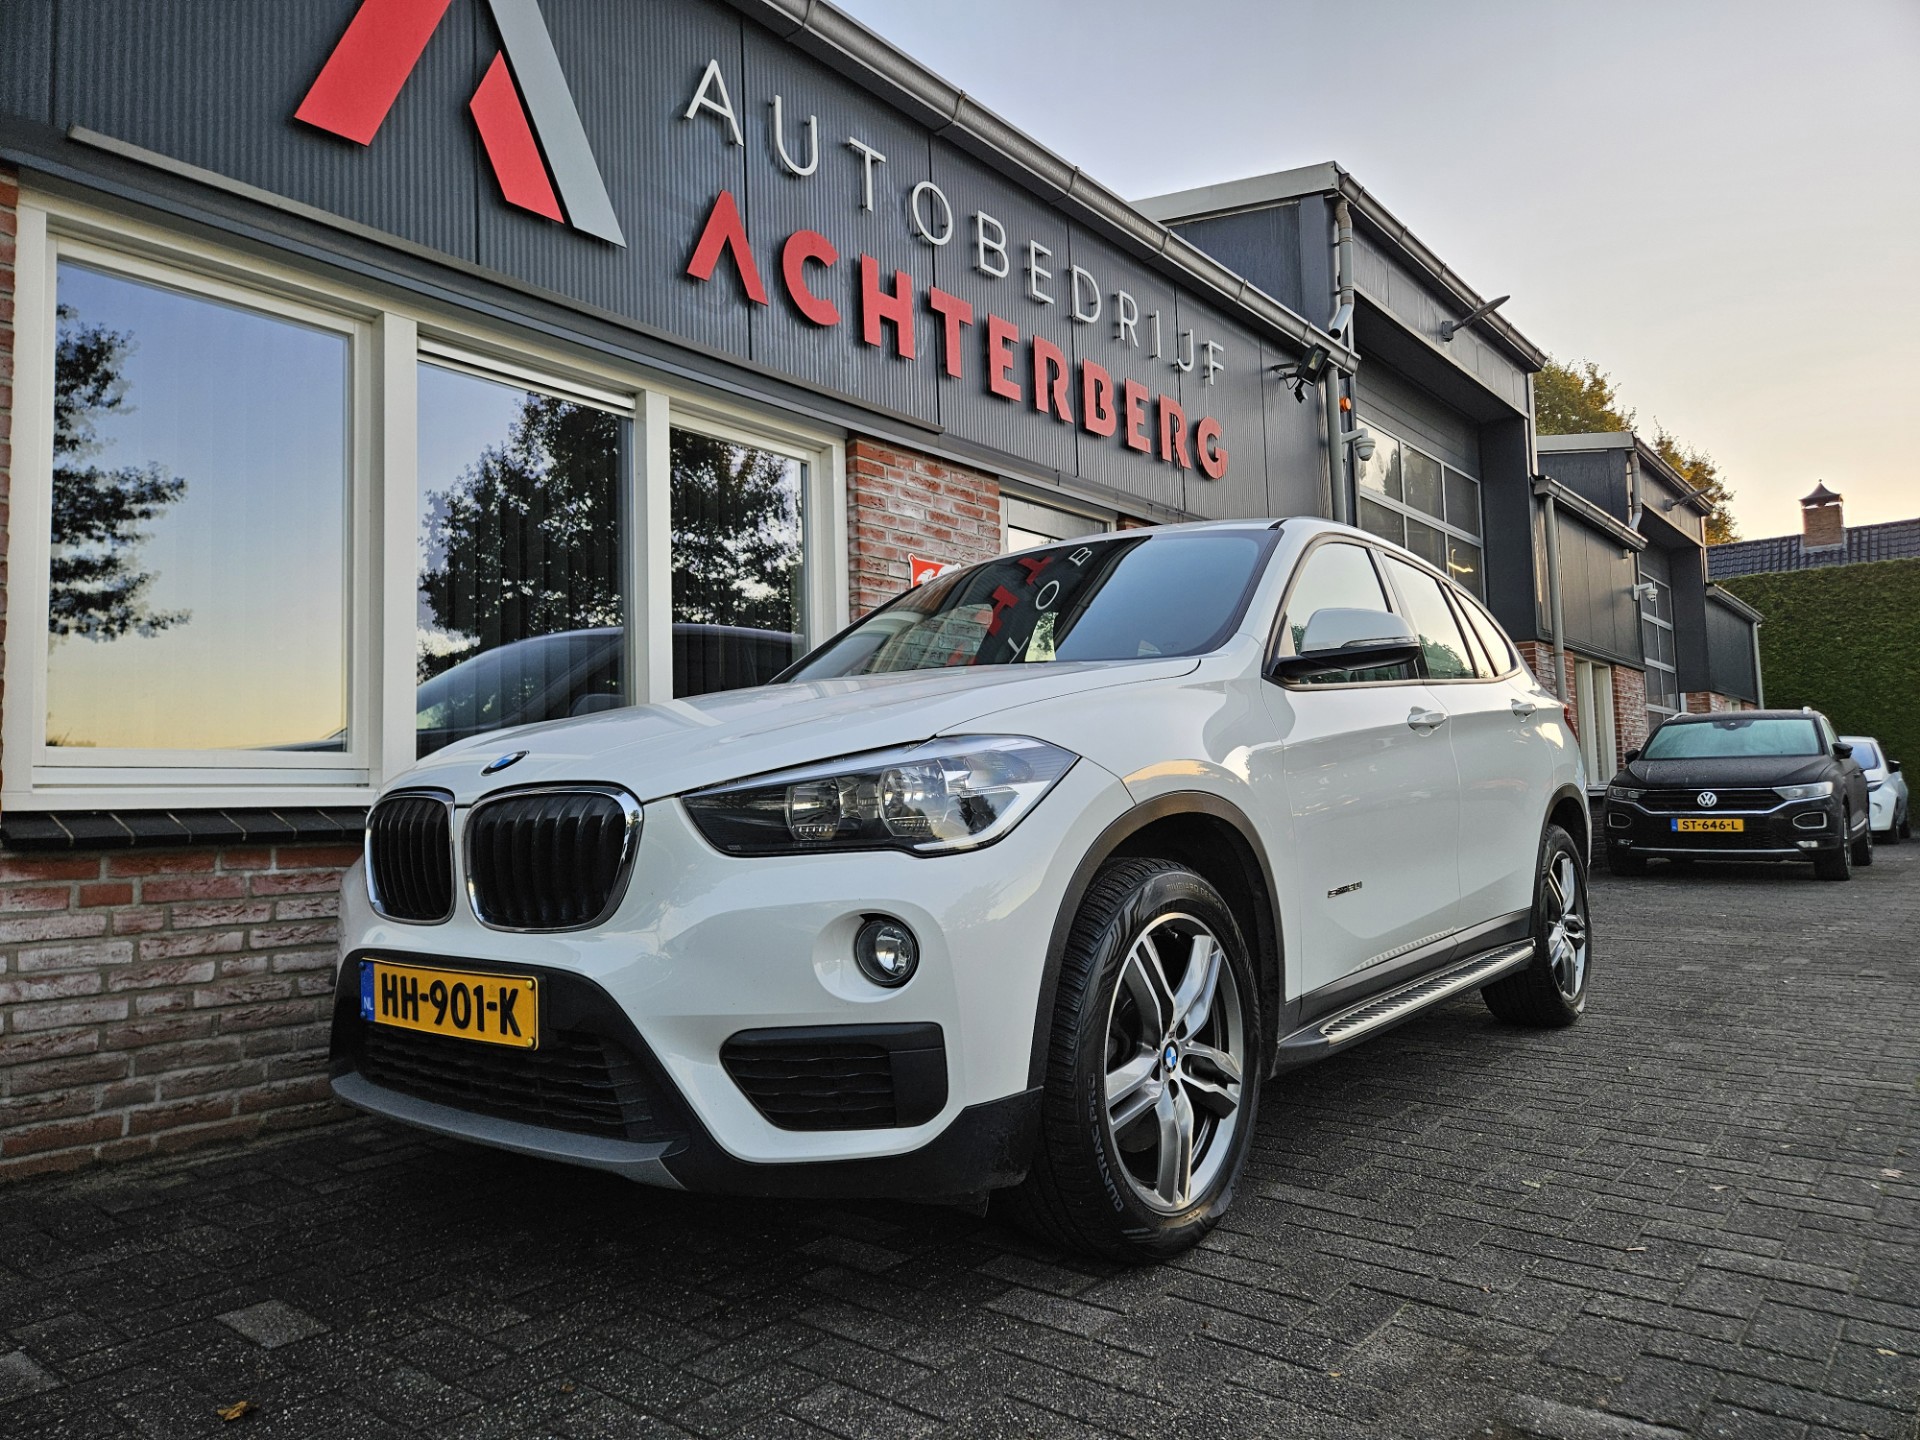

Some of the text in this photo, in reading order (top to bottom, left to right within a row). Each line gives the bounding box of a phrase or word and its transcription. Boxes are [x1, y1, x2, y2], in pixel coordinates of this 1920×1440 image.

[684, 59, 1225, 385] AUTOBEDRIJF
[687, 189, 1229, 480] ACHTERBERG
[1682, 820, 1739, 831] ST-646-L
[363, 996, 374, 1011] NL
[381, 972, 522, 1038] HH-901-K
